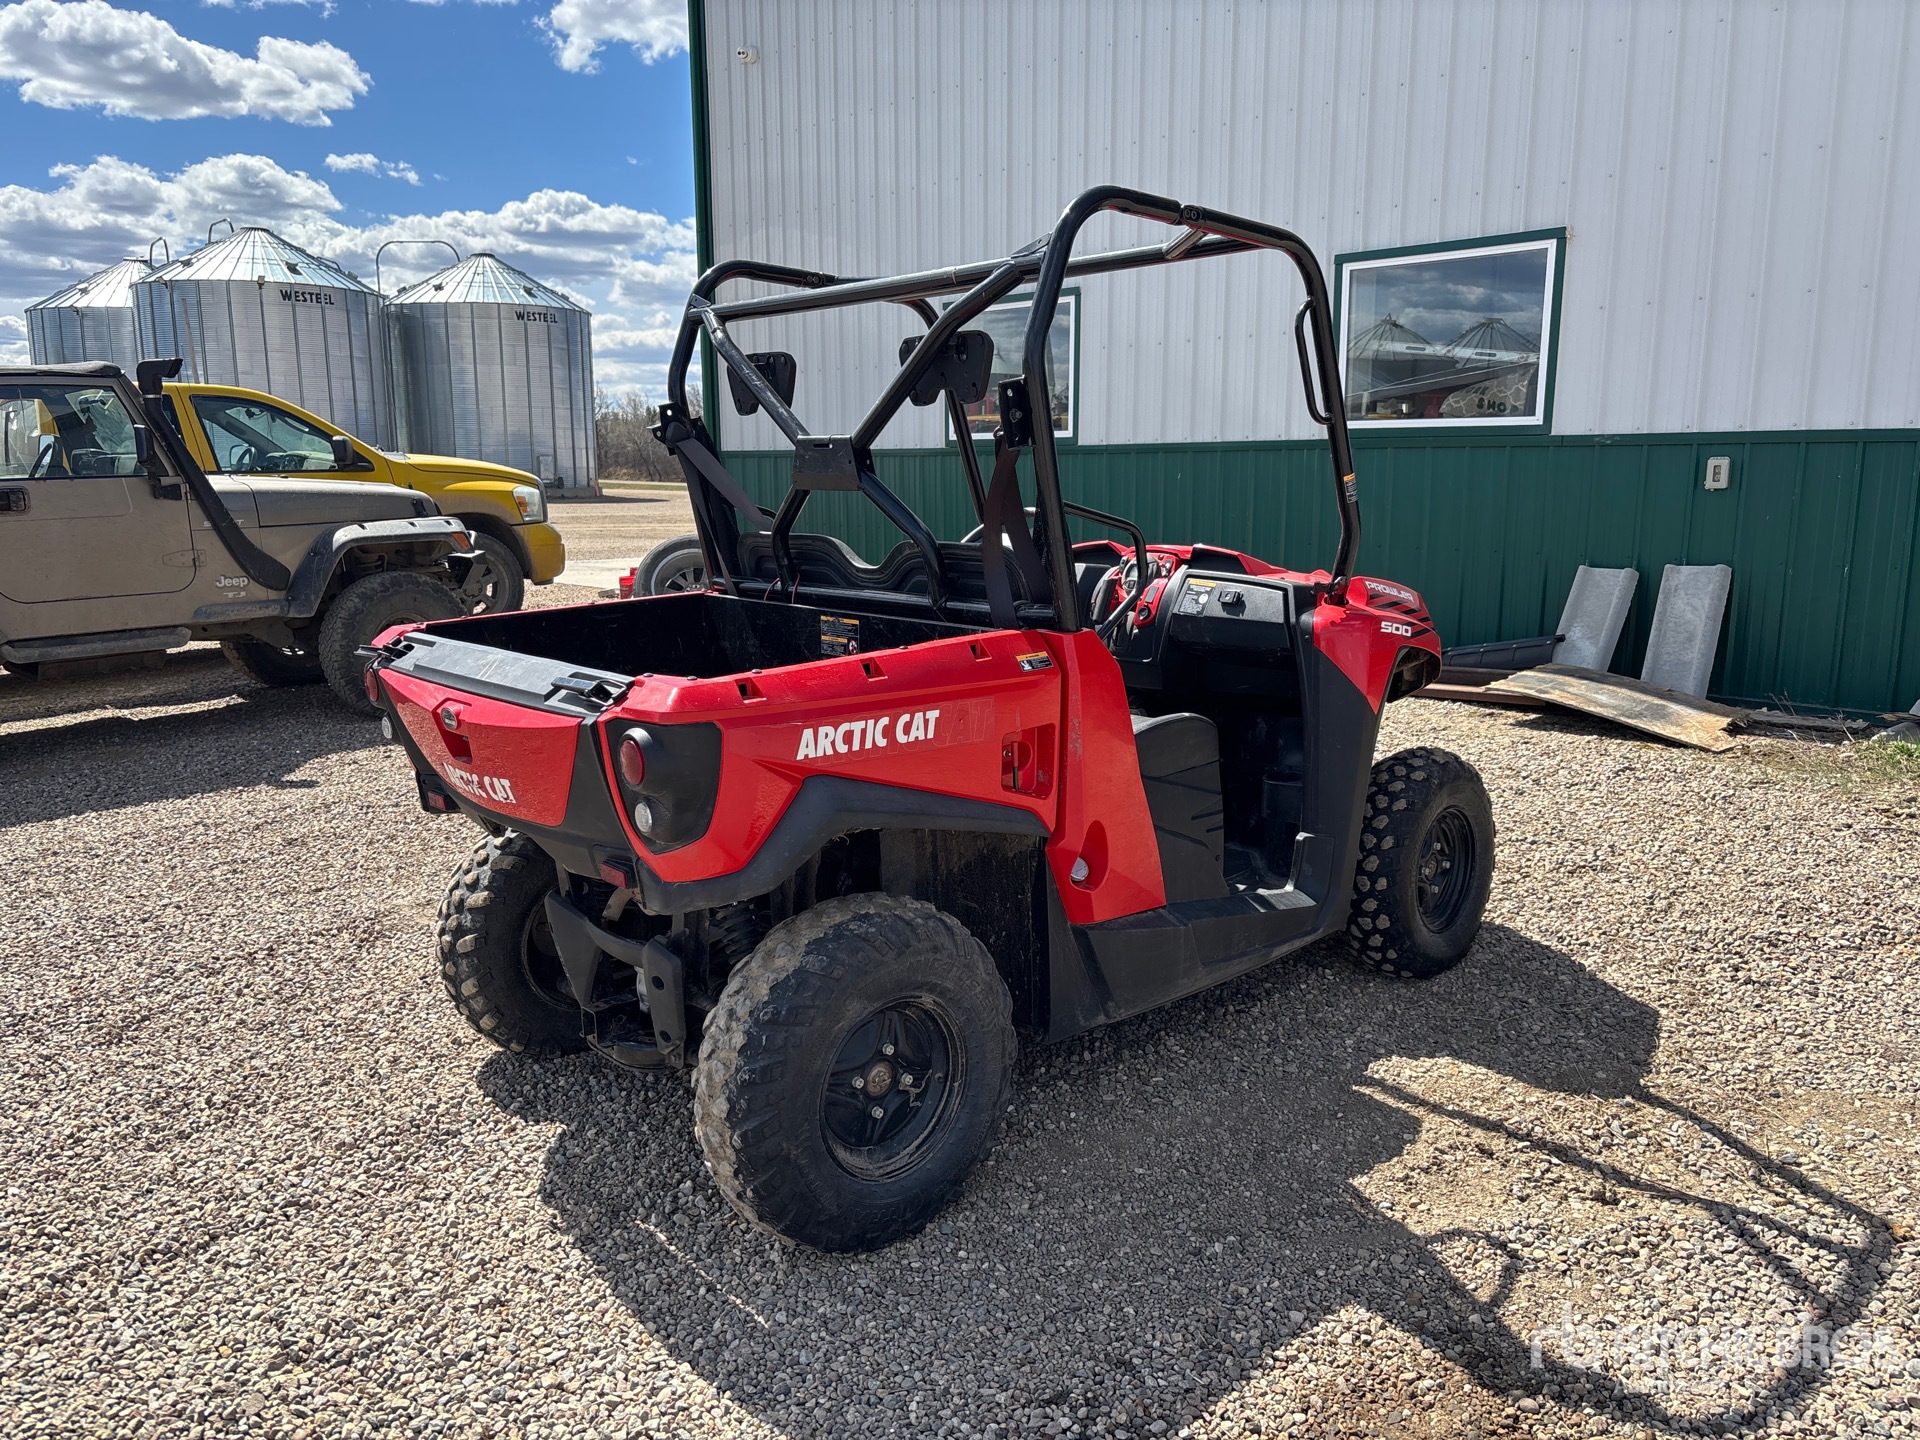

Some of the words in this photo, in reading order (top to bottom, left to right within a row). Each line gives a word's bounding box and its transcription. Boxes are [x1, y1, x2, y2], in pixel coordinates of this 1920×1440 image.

[280, 289, 334, 305] WESTEEL
[515, 310, 558, 324] WESTEEL
[215, 575, 250, 588] Jeep
[1364, 580, 1415, 603] PROWLER
[1380, 621, 1412, 637] 500
[796, 716, 890, 761] ARCTIC
[896, 709, 940, 744] CAT
[483, 775, 517, 804] CAT
